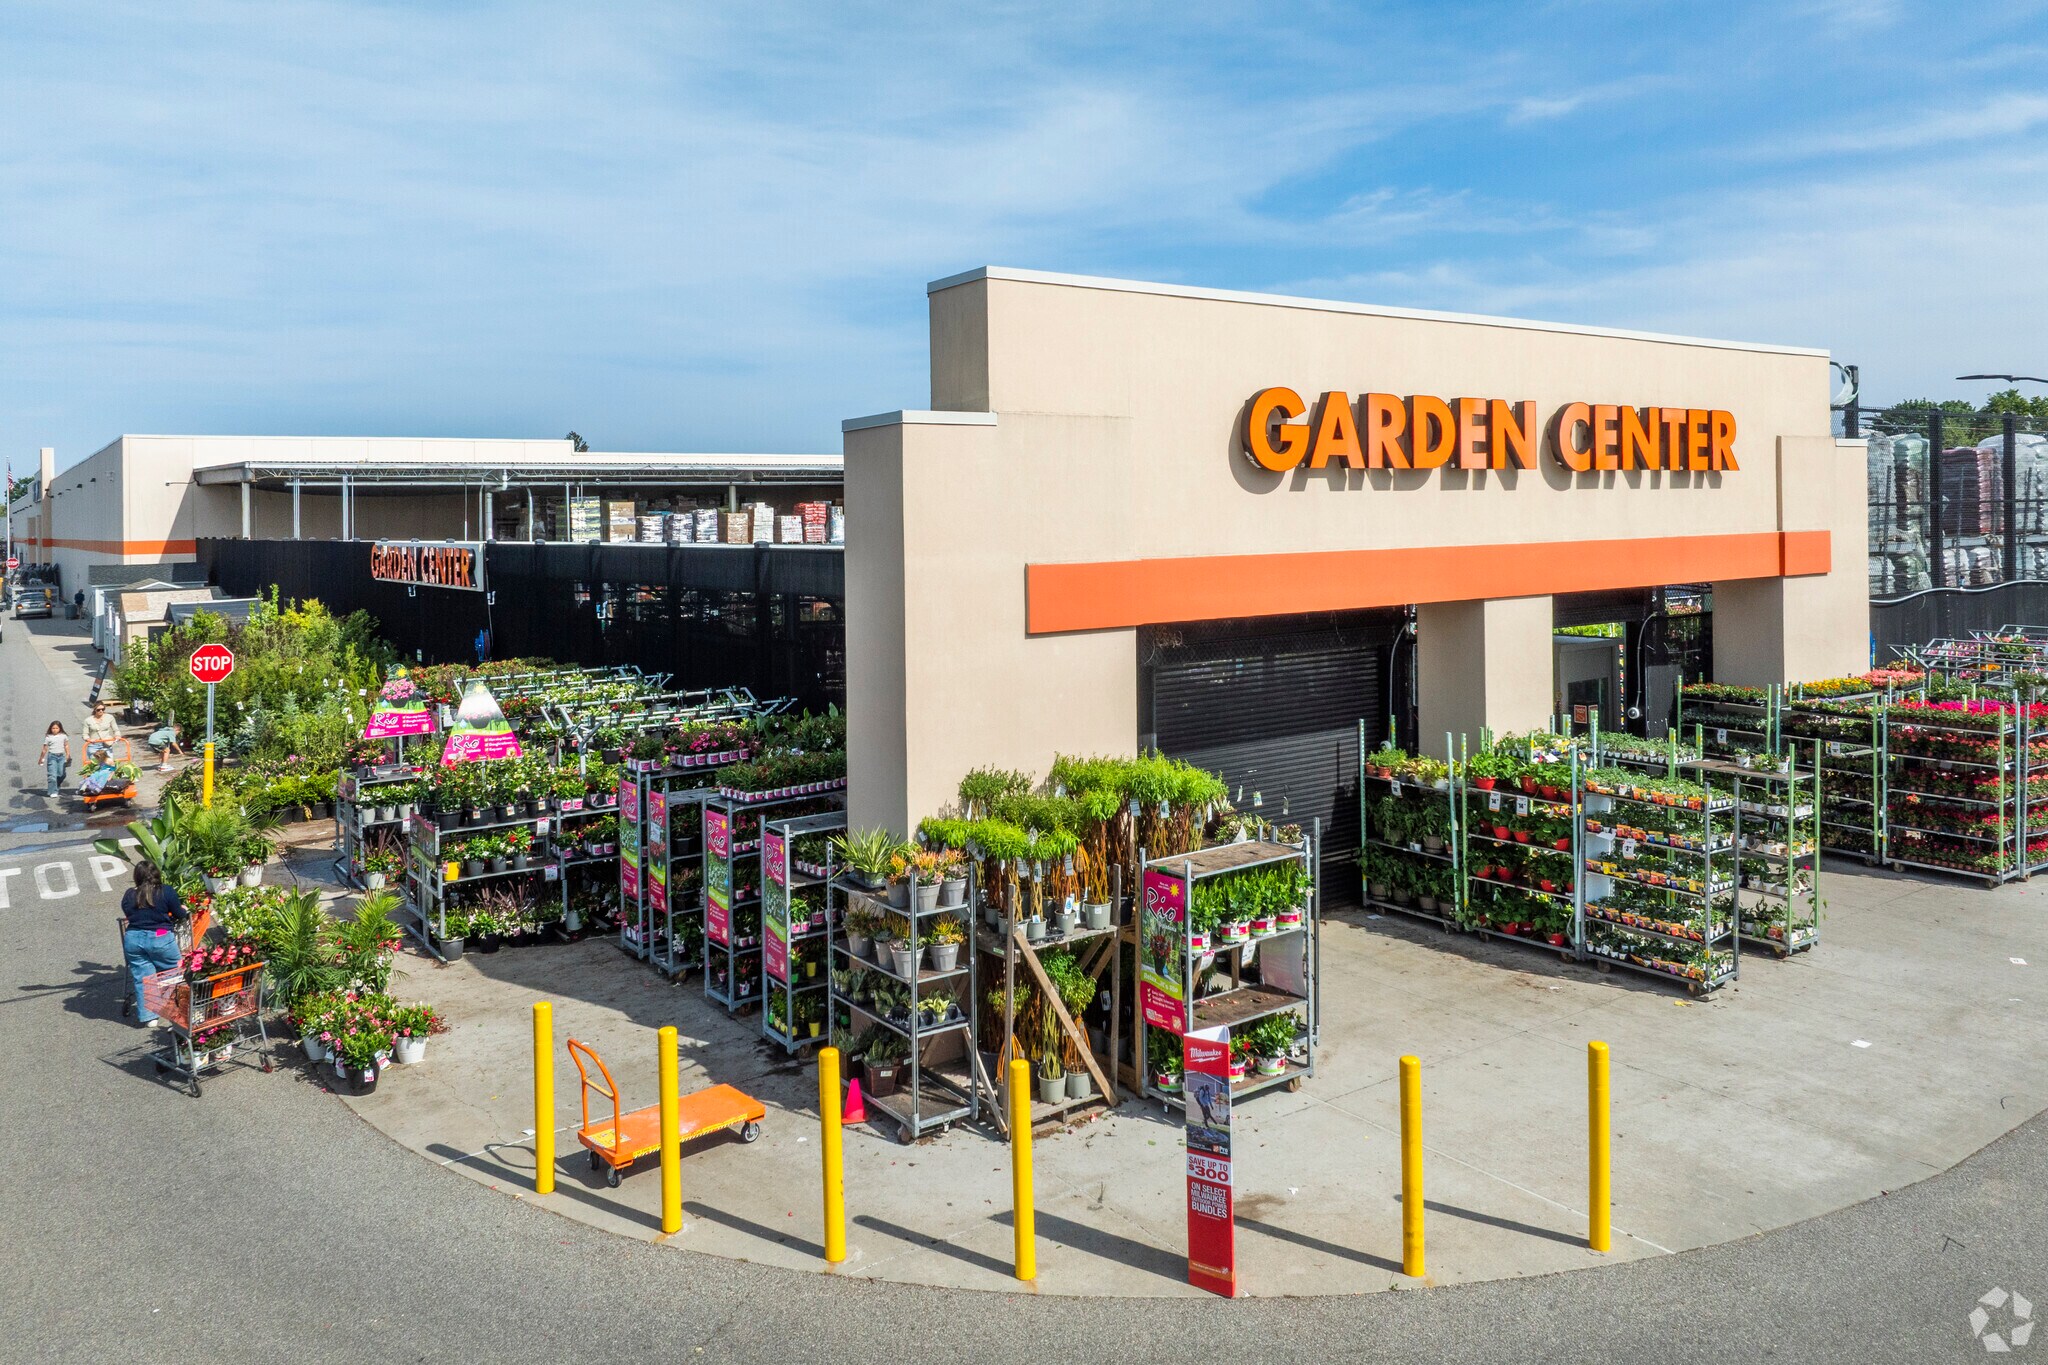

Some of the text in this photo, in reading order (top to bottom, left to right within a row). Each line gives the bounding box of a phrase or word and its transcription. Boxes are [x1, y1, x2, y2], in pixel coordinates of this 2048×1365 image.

[1243, 387, 1740, 471] GARDEN CENTER
[371, 544, 471, 587] GARDEN CENTER
[193, 658, 231, 671] STOP
[374, 712, 399, 727] Rio
[452, 734, 480, 751] Rio
[707, 820, 725, 848] Rio
[766, 843, 783, 874] Rio
[1146, 887, 1176, 922] Rio
[1189, 1046, 1222, 1058] Milwaukee
[1189, 1156, 1228, 1172] SAVE UP TO
[1189, 1164, 1228, 1181] $300
[1191, 1189, 1227, 1204] MILWAUKEE
[1192, 1182, 1226, 1197] ON SELECT
[1192, 1202, 1227, 1218] BUNDLES
